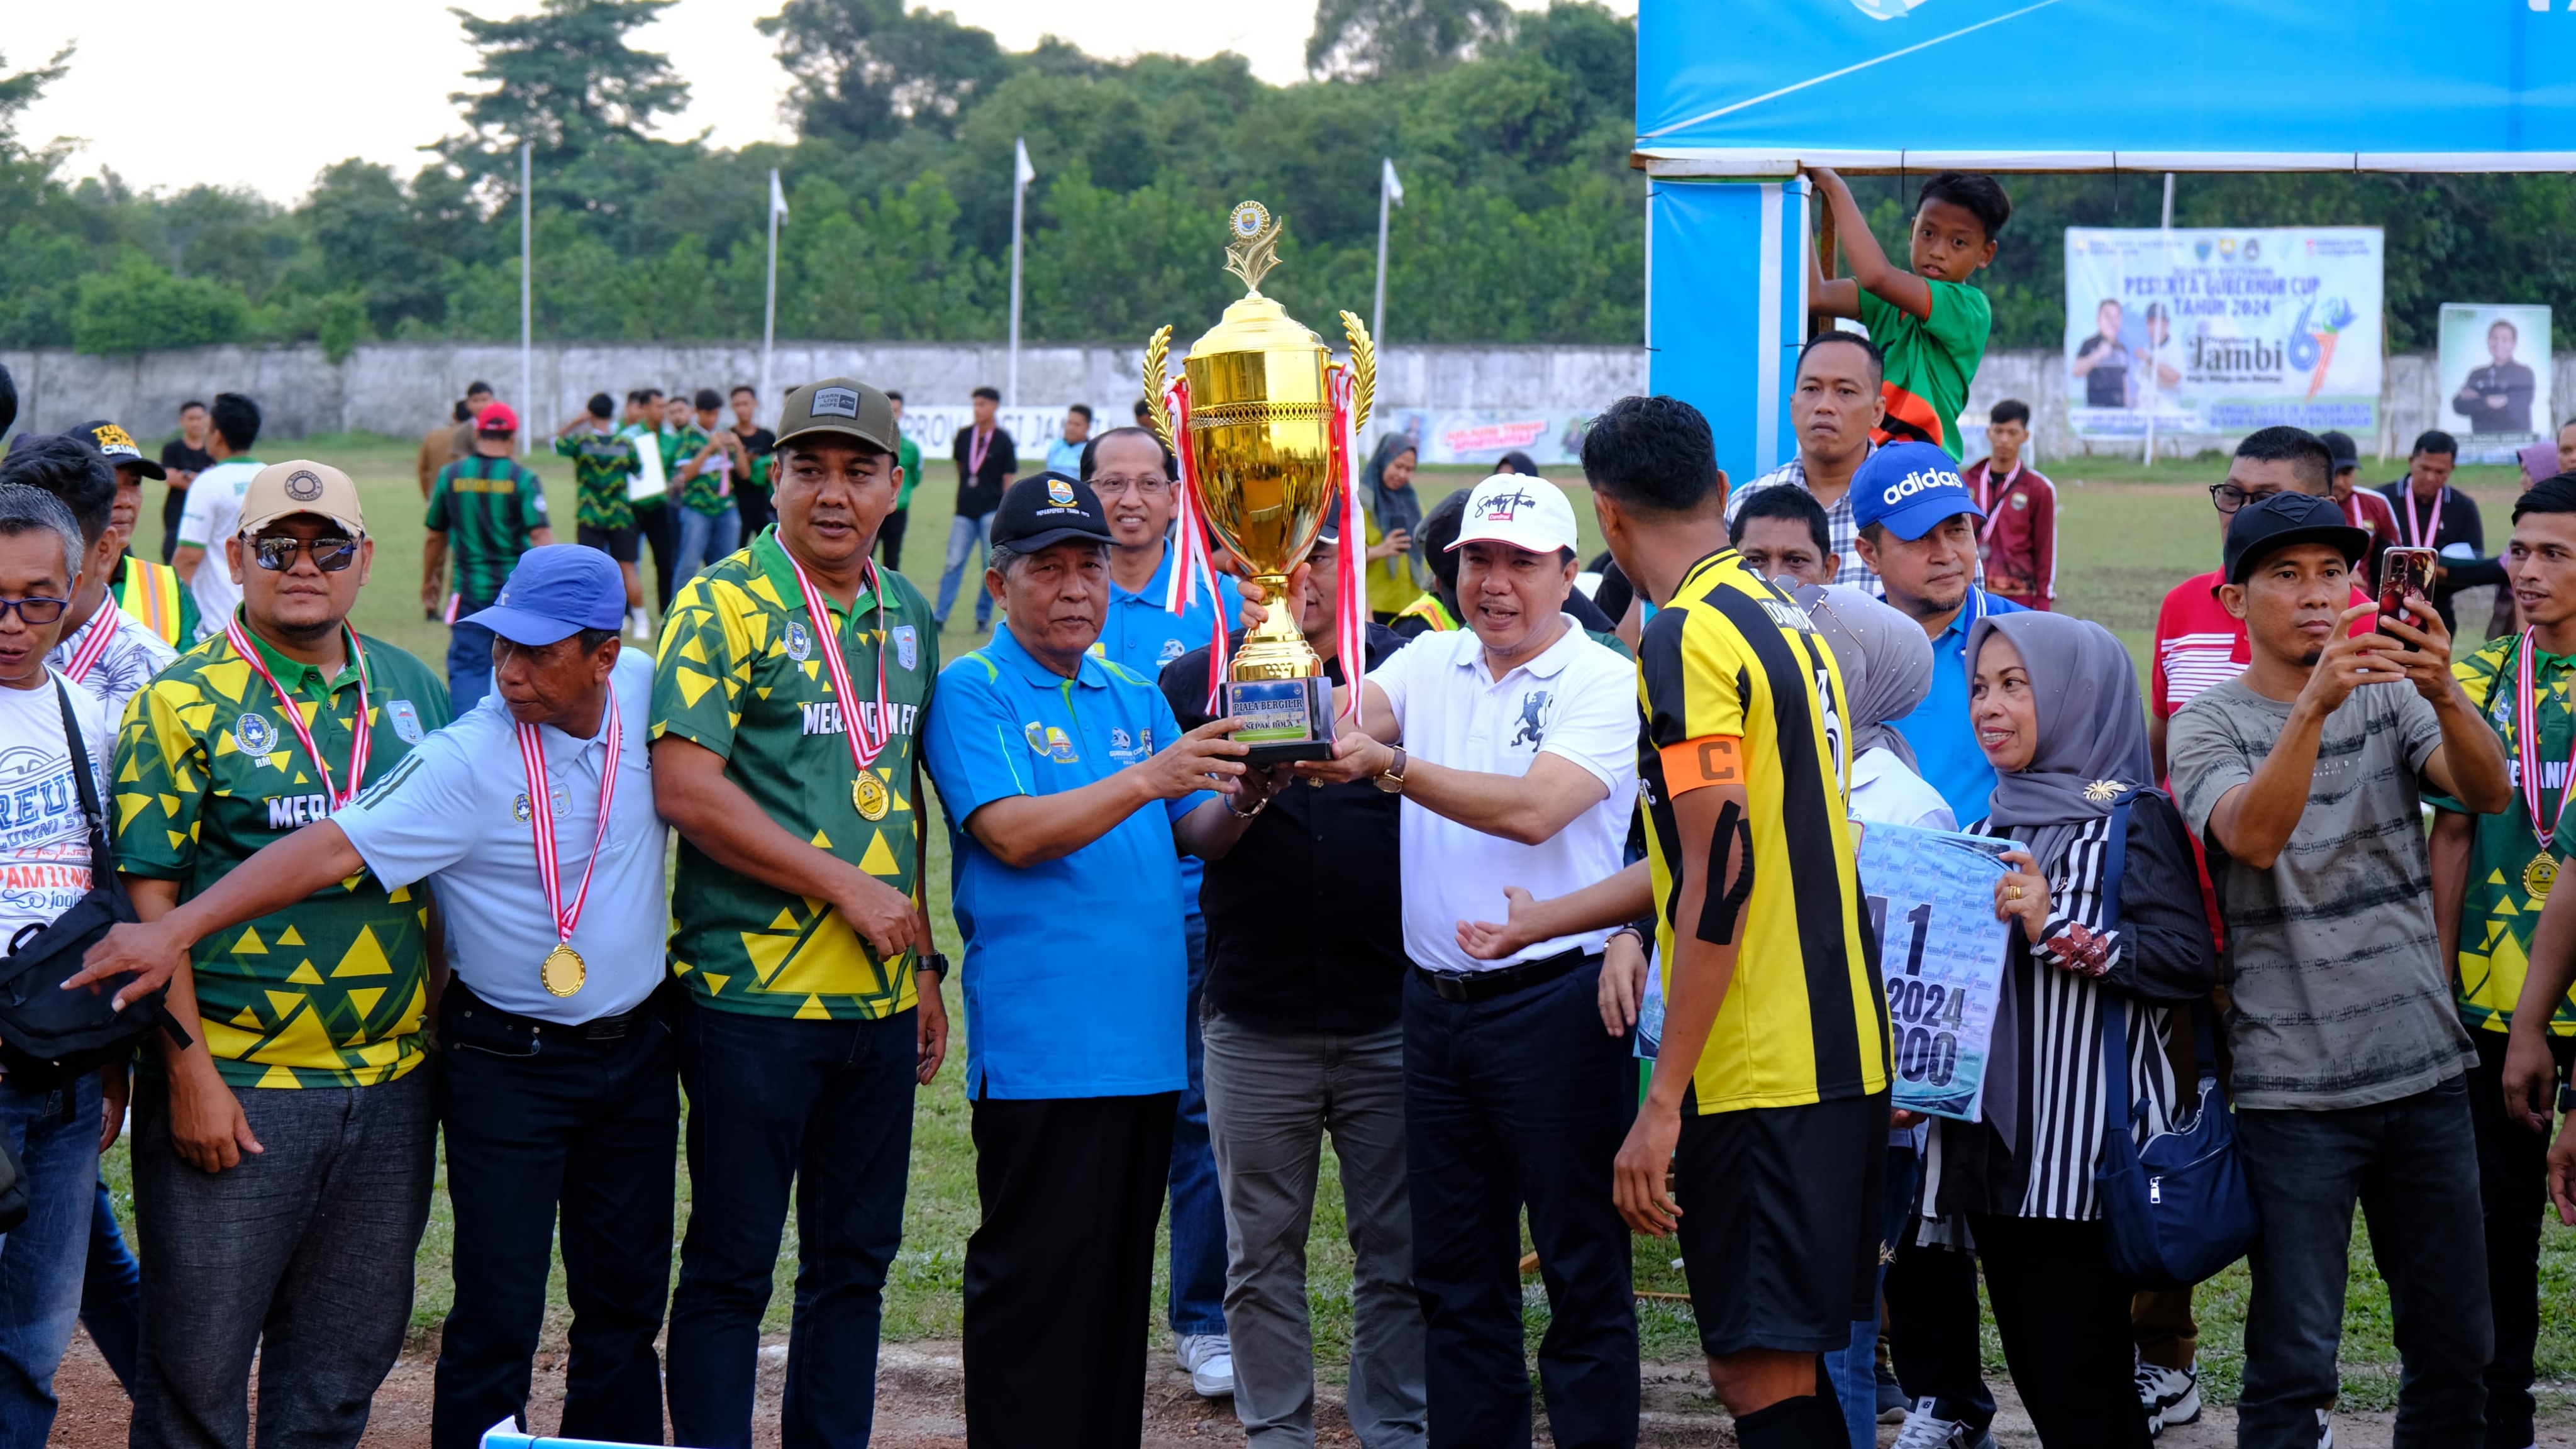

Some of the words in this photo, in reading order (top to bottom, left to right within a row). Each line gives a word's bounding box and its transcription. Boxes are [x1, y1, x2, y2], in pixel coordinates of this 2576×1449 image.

[2291, 275, 2321, 296] CUP
[2231, 298, 2272, 316] 2024
[2188, 336, 2282, 372] Jambi
[289, 472, 319, 484] BURBERRY
[1884, 467, 1963, 505] adidas
[291, 491, 318, 499] ENGLAND
[1233, 701, 1259, 712] PIALA
[1261, 698, 1304, 709] BERGILIR
[1246, 721, 1270, 730] SEPAK
[1272, 719, 1294, 728] BOLA
[255, 756, 272, 768] RM
[1697, 740, 1735, 781] C
[1906, 903, 1932, 977] 1
[1886, 977, 1966, 1031] 2024
